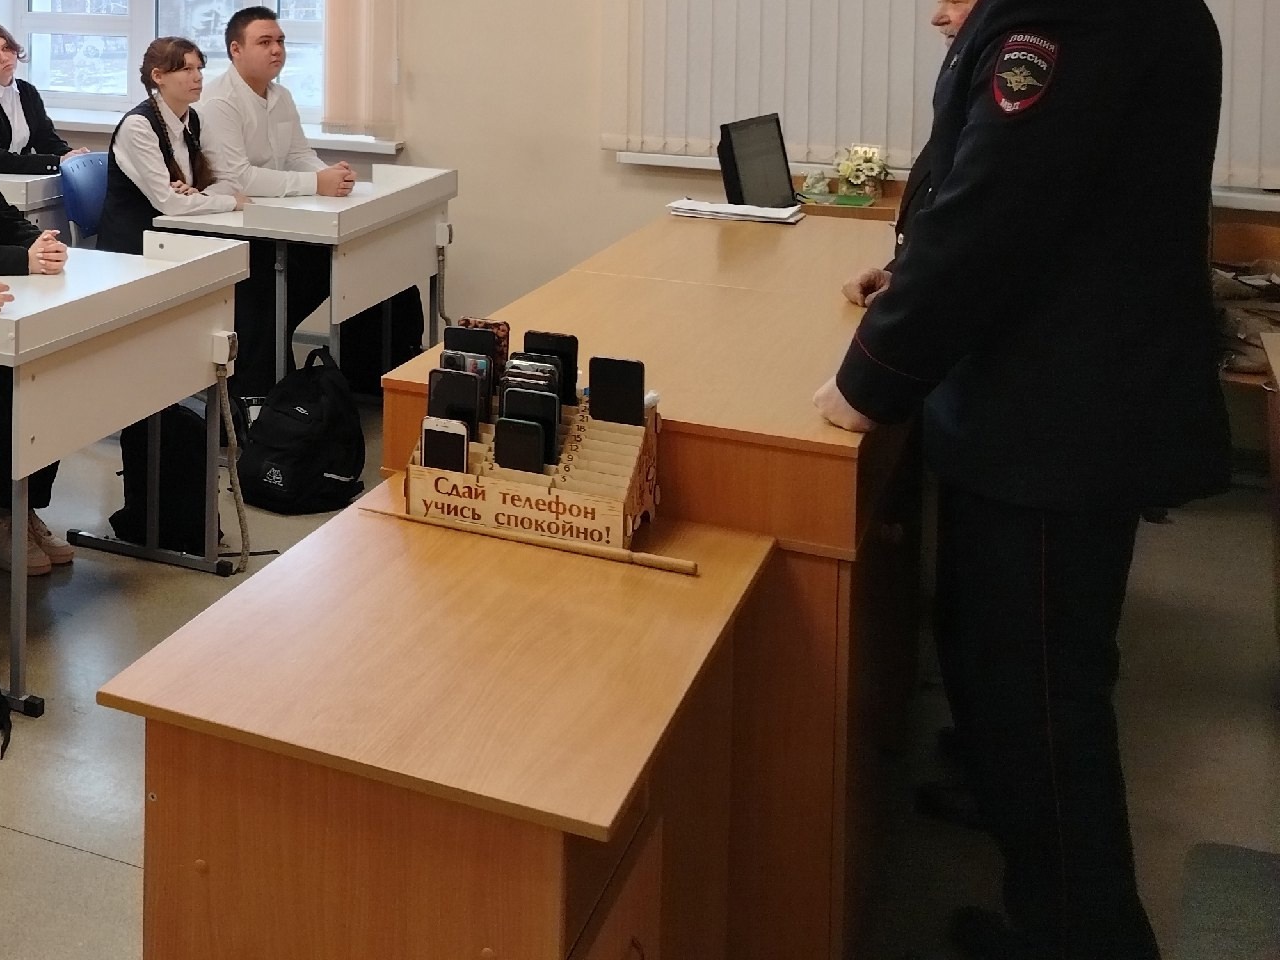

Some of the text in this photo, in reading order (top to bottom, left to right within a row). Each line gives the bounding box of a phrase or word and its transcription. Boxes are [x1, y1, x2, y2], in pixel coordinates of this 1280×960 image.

[1008, 34, 1056, 53] ПОЛИЦИЯ
[1003, 51, 1049, 71] РОССИЯ
[999, 97, 1021, 112] МВД
[579, 414, 589, 423] 21
[576, 424, 587, 433] 18
[569, 444, 580, 452] 12
[567, 454, 574, 462] 9
[563, 464, 571, 473] 6
[434, 476, 597, 521] Сдай телефон
[494, 512, 612, 545] спокойно!
